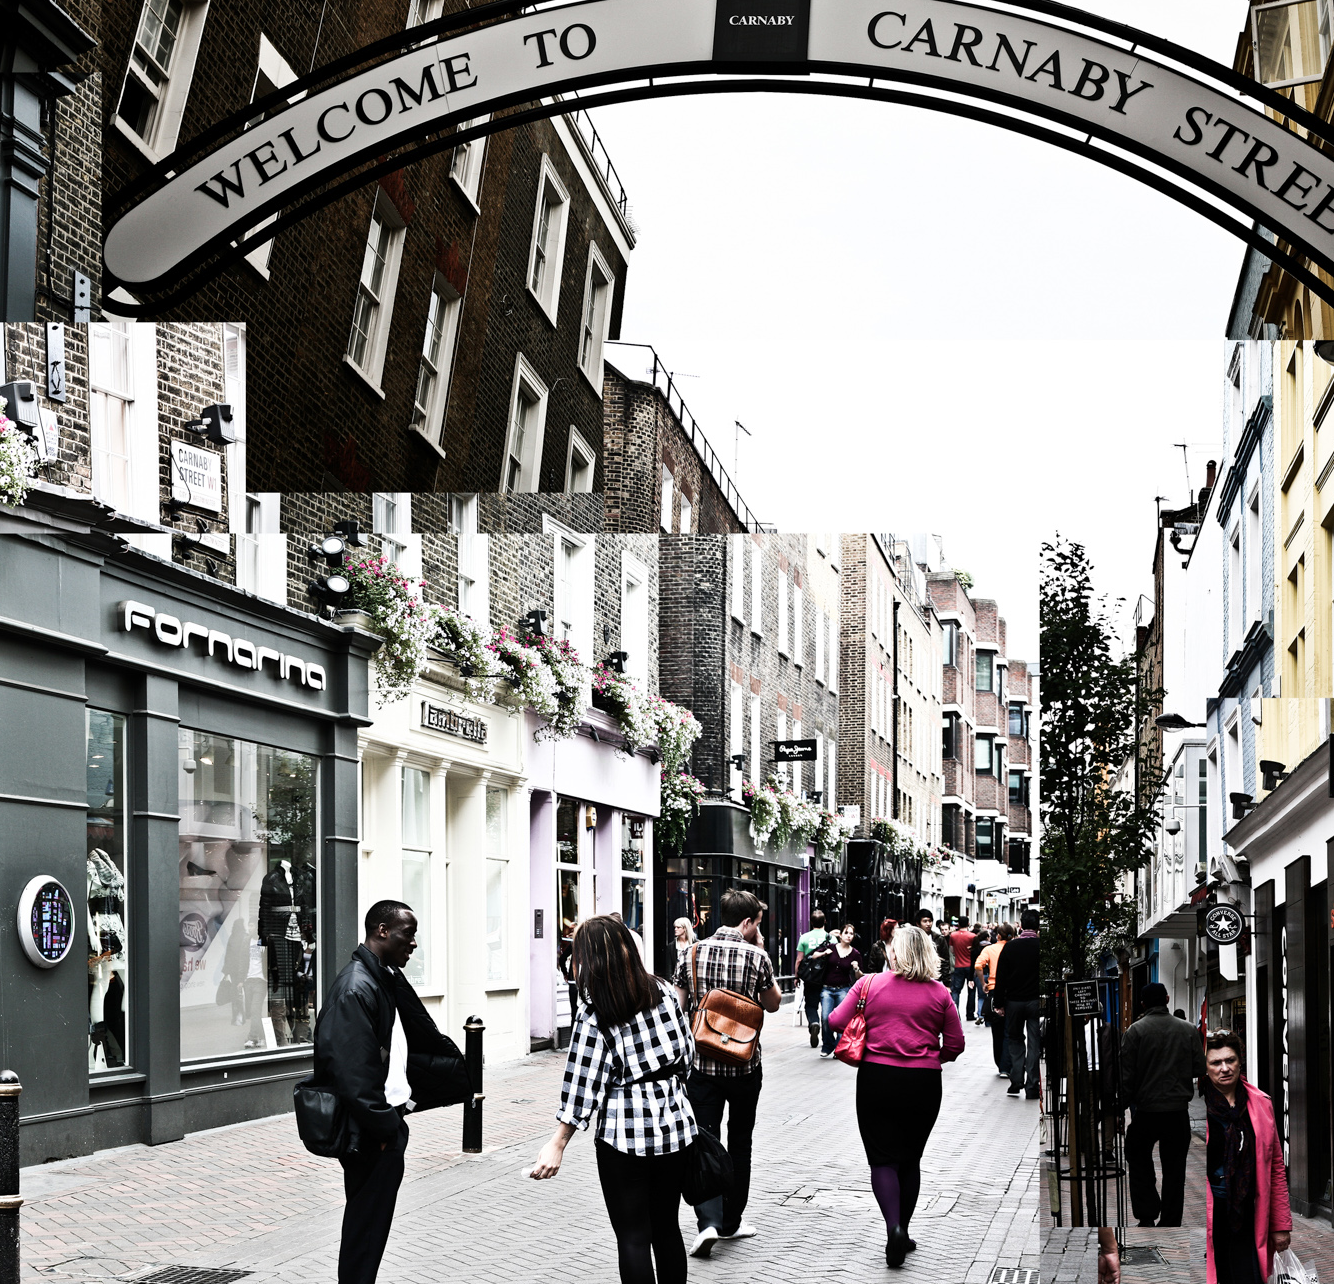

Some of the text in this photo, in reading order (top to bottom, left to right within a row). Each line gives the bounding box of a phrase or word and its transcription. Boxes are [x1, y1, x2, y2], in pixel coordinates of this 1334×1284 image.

[728, 14, 796, 26] CARNABY
[193, 52, 479, 209] WELCOME
[523, 23, 598, 69] TO
[866, 10, 1156, 116] CARNABY
[178, 447, 213, 472] CARNABY
[178, 466, 217, 491] STREET W1
[792, 744, 813, 755] Jeans
[1210, 910, 1237, 921] CONVERSE
[1212, 929, 1236, 939] ALL STAR
